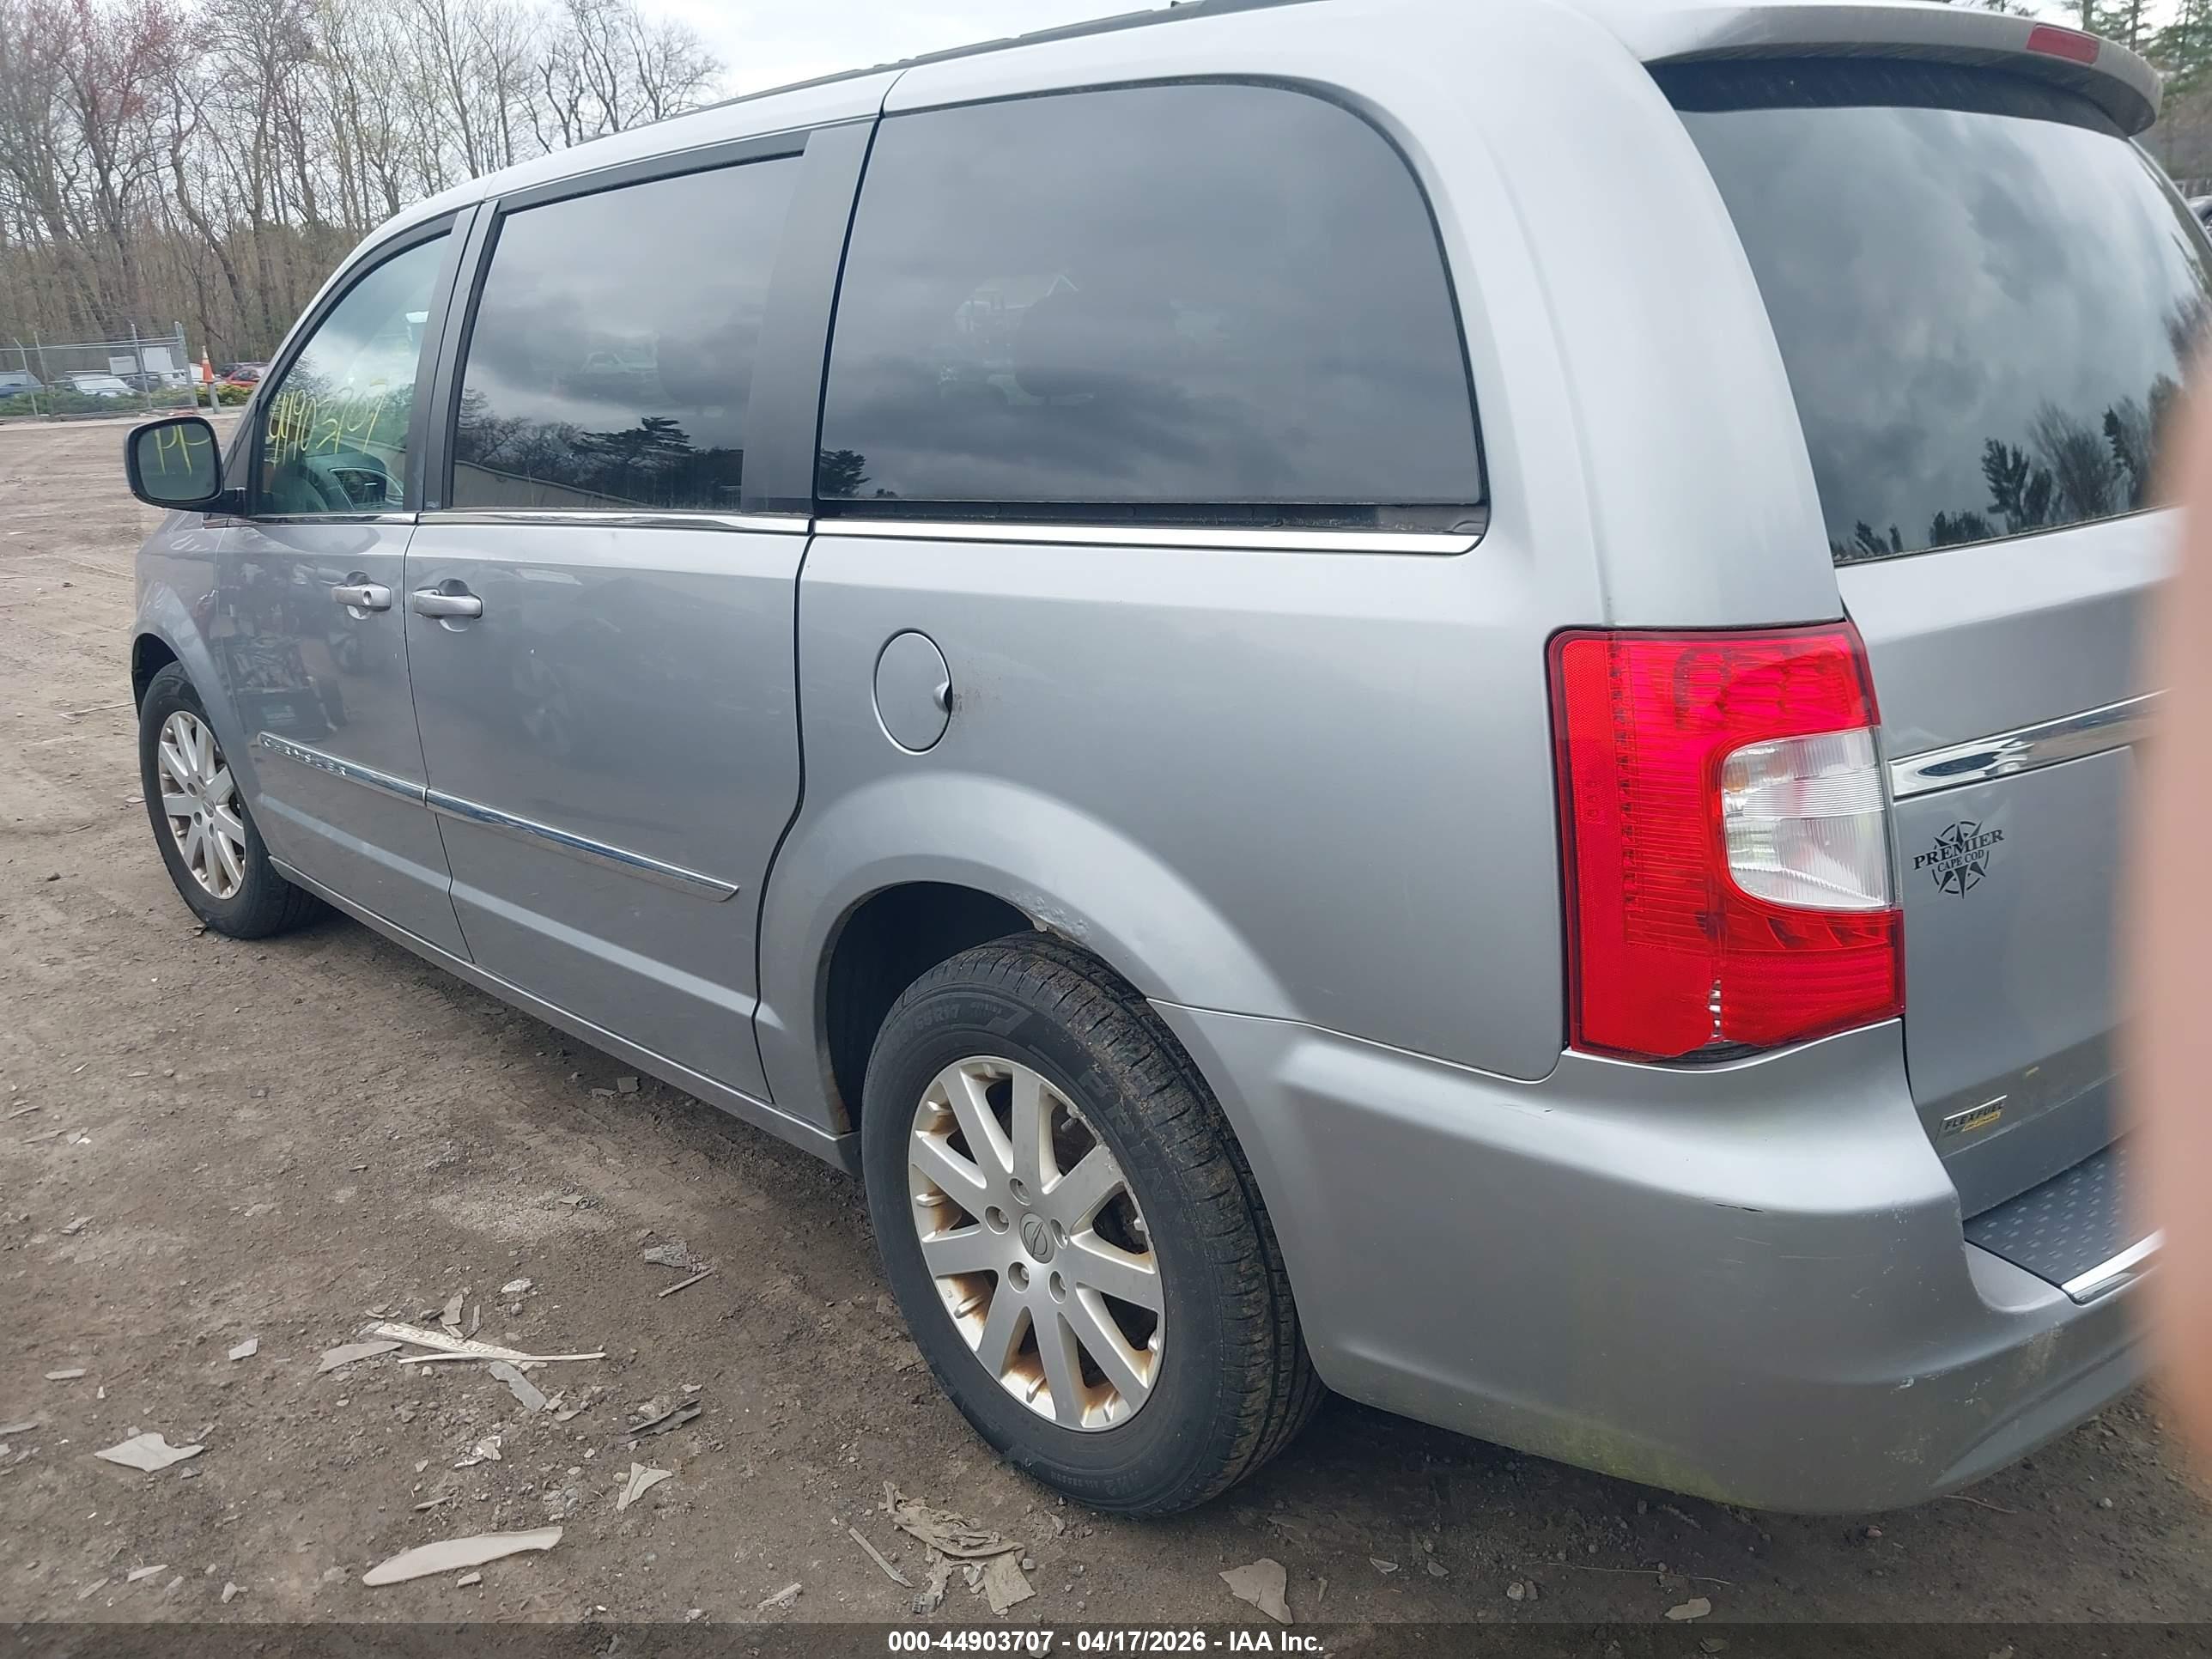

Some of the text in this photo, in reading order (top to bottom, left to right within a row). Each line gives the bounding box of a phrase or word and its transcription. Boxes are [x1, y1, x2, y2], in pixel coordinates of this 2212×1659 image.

[1912, 830, 2005, 871] PREMIER
[1937, 849, 1984, 872] CAPE COD
